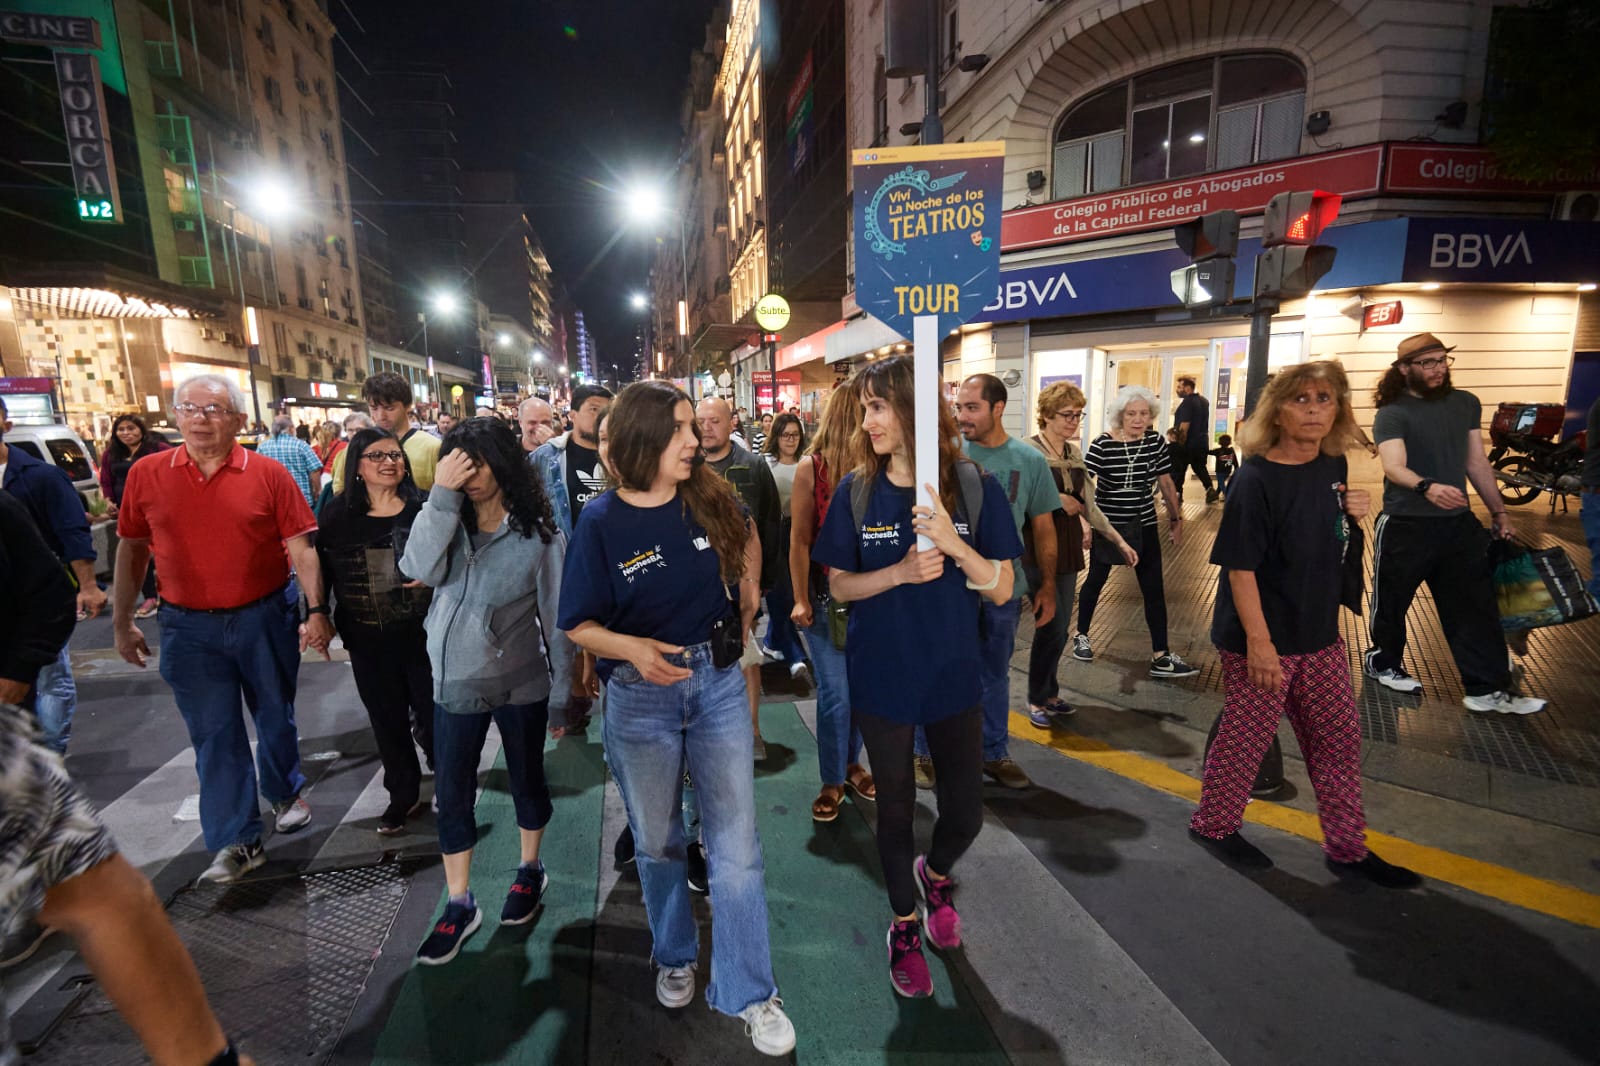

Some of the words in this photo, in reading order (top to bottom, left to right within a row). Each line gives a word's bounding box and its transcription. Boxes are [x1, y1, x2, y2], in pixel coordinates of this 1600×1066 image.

[2, 15, 89, 36] CINE
[61, 58, 103, 195] LORCA
[1418, 158, 1498, 184] Colegio
[889, 204, 902, 215] La
[905, 198, 942, 213] Noche
[946, 193, 962, 204] de
[965, 189, 984, 200] los
[1054, 201, 1107, 220] Colegio
[1112, 190, 1168, 210] Público
[1173, 185, 1193, 199] de
[1197, 170, 1285, 194] Abogados
[889, 202, 985, 241] TEATROS
[1053, 223, 1070, 236] de
[1075, 219, 1087, 232] la
[1091, 210, 1143, 229] Capital
[1149, 199, 1208, 220] Federal
[1430, 230, 1533, 268] BBVA
[760, 306, 786, 315] Subte
[894, 283, 959, 315] TOUR
